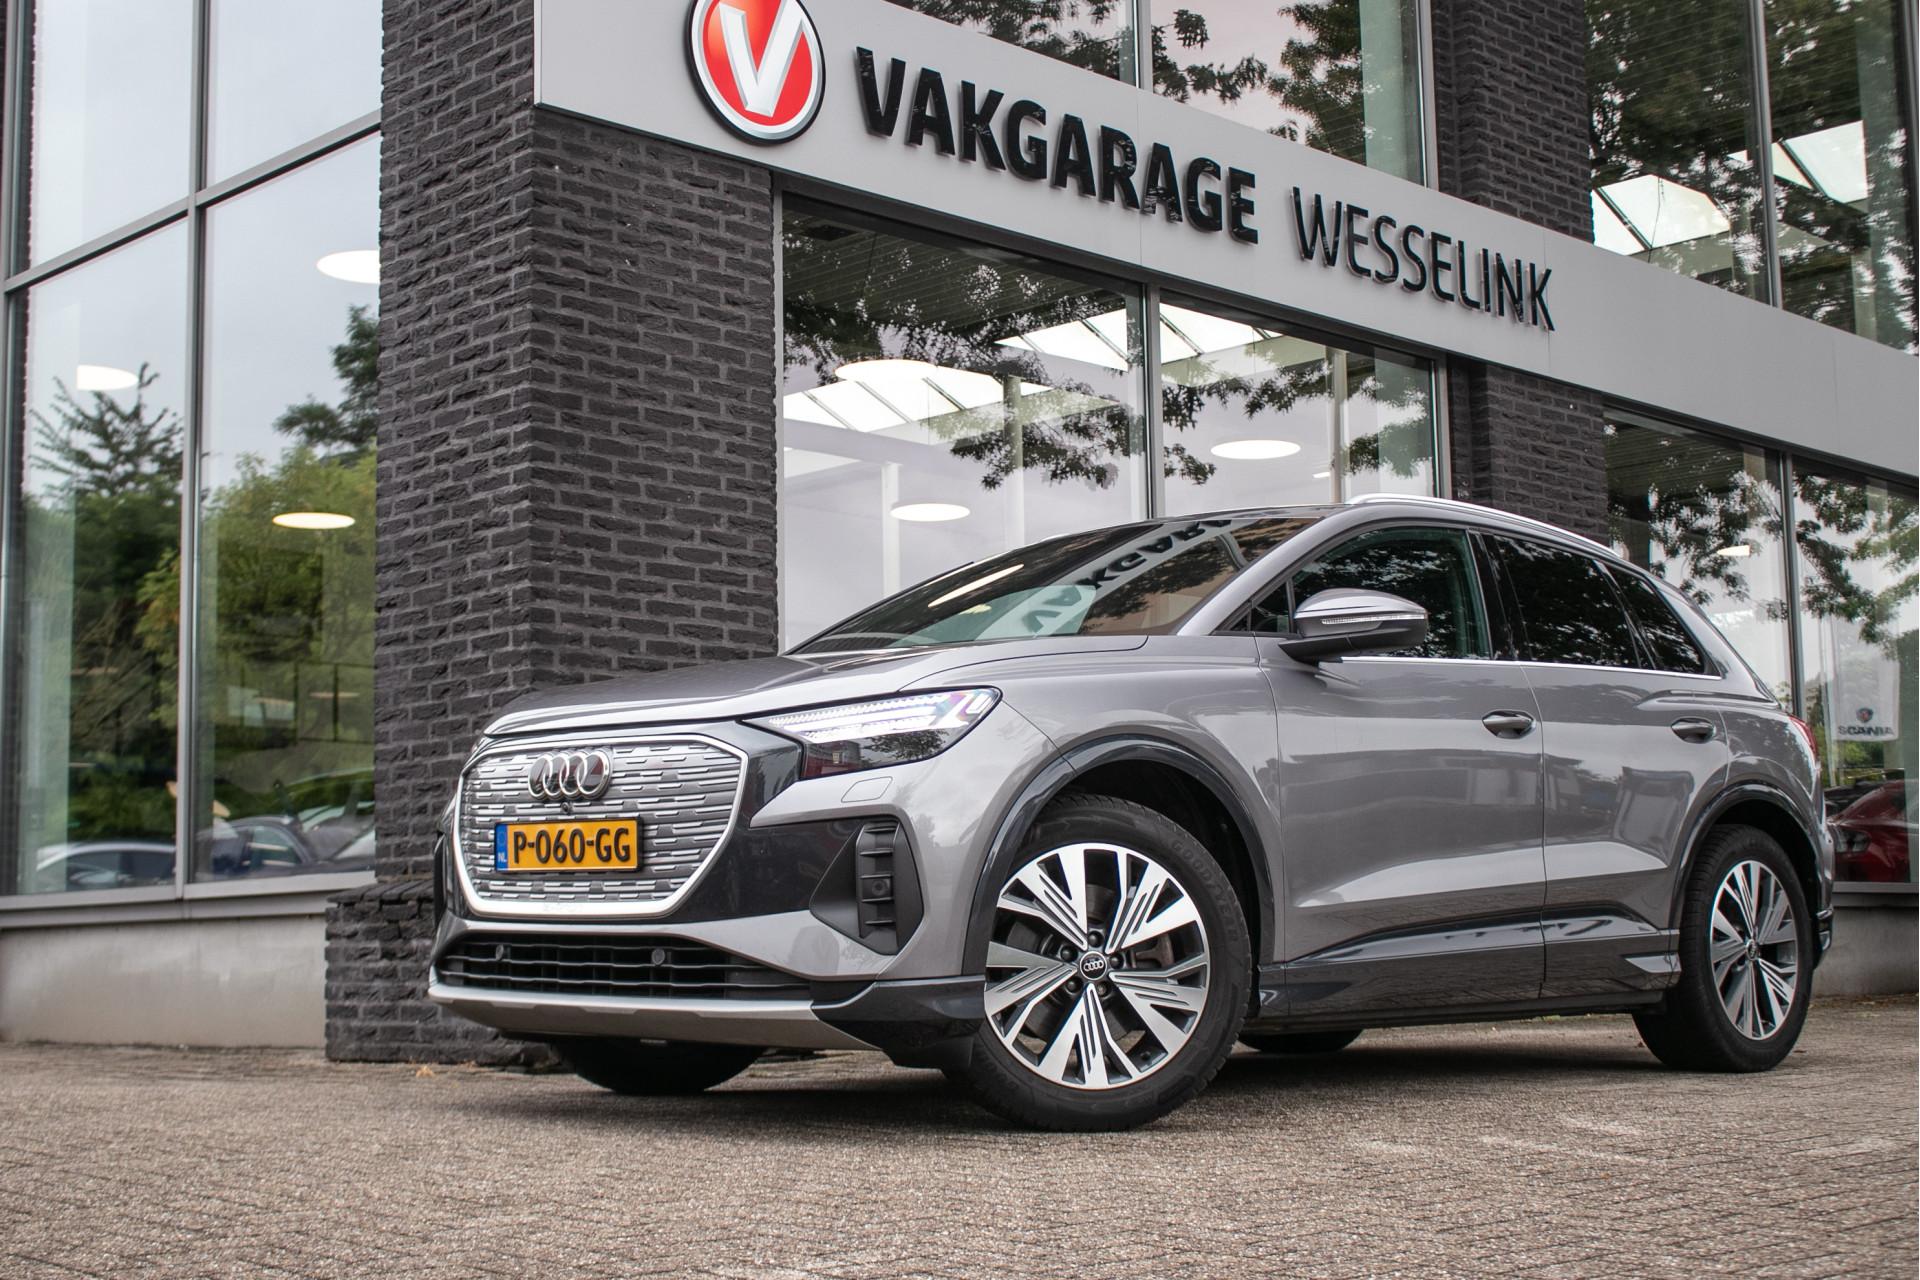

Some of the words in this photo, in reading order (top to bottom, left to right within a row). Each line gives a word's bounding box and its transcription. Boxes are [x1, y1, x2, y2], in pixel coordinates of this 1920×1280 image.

[856, 46, 1258, 244] VAKGARAGE
[1291, 186, 1555, 332] WESSELINK
[1838, 726, 1894, 737] SCANIA
[513, 828, 631, 864] P-060-GG
